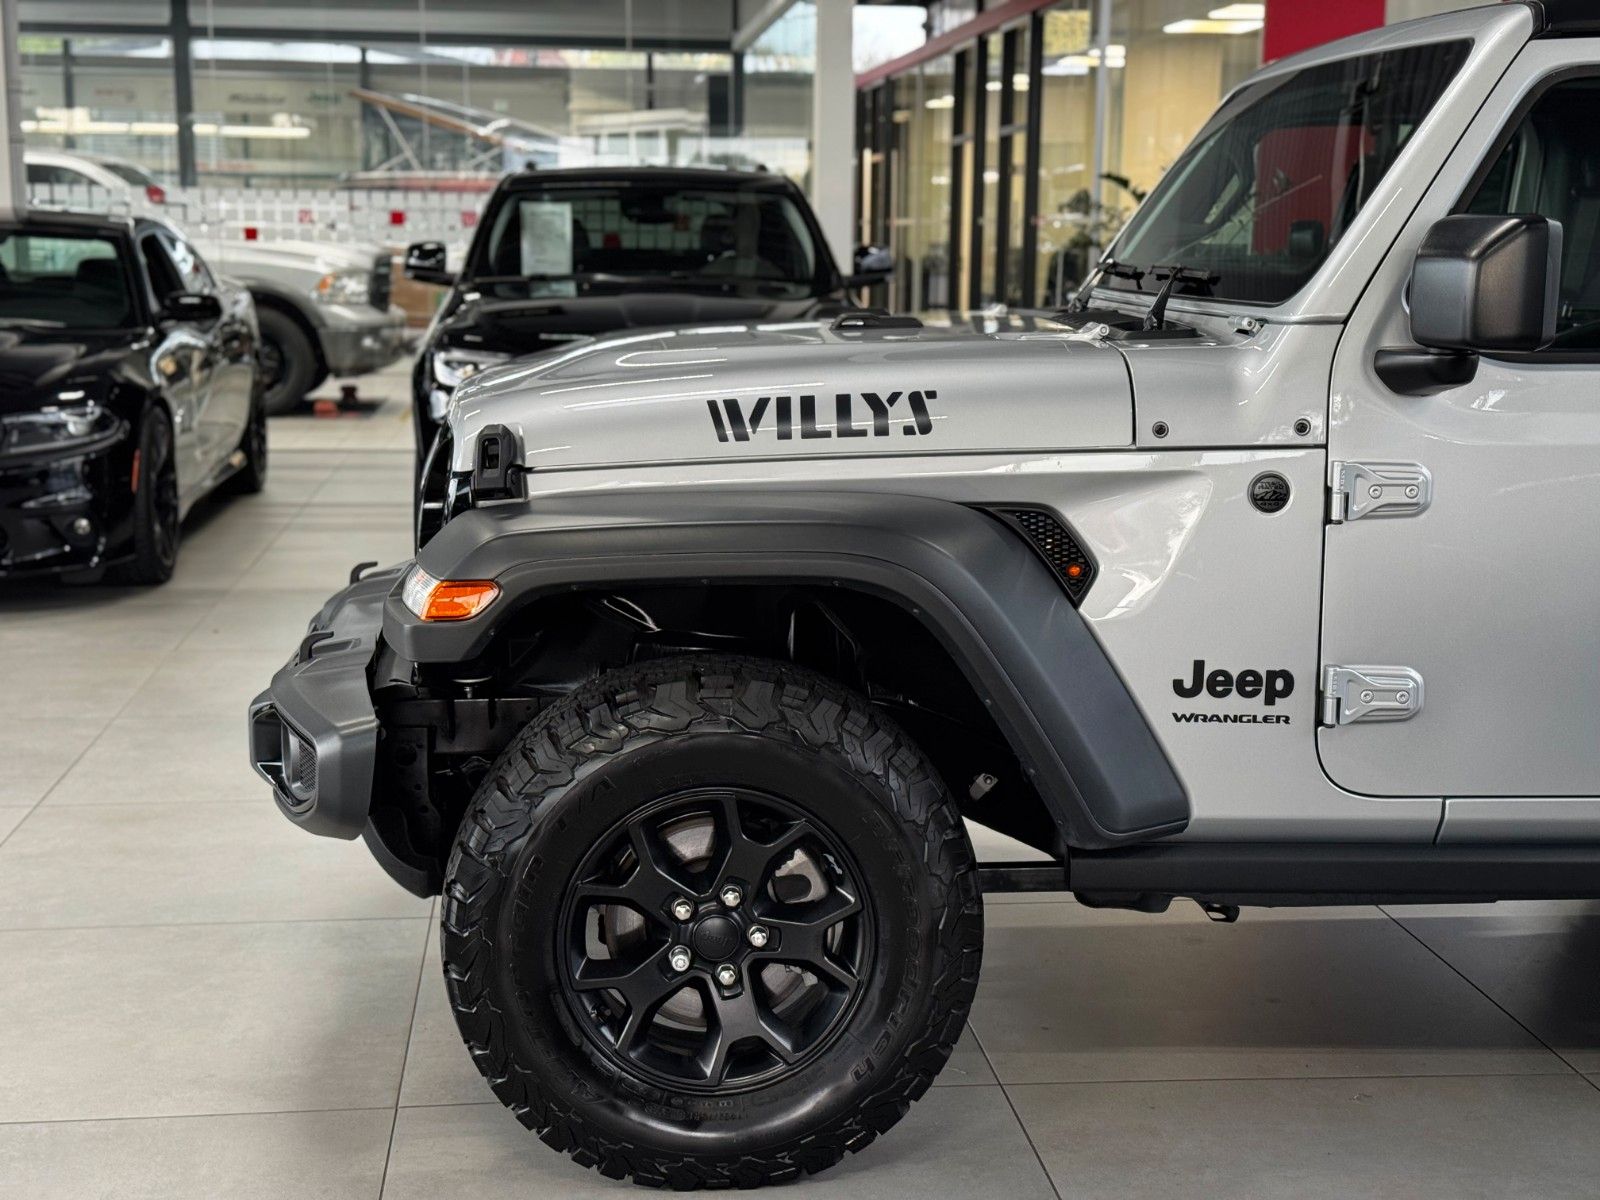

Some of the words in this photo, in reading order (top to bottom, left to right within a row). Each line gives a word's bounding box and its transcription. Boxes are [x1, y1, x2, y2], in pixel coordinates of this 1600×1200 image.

[706, 390, 938, 443] WILLYS
[1172, 660, 1295, 706] Jeep
[1172, 712, 1291, 725] WRANGLER
